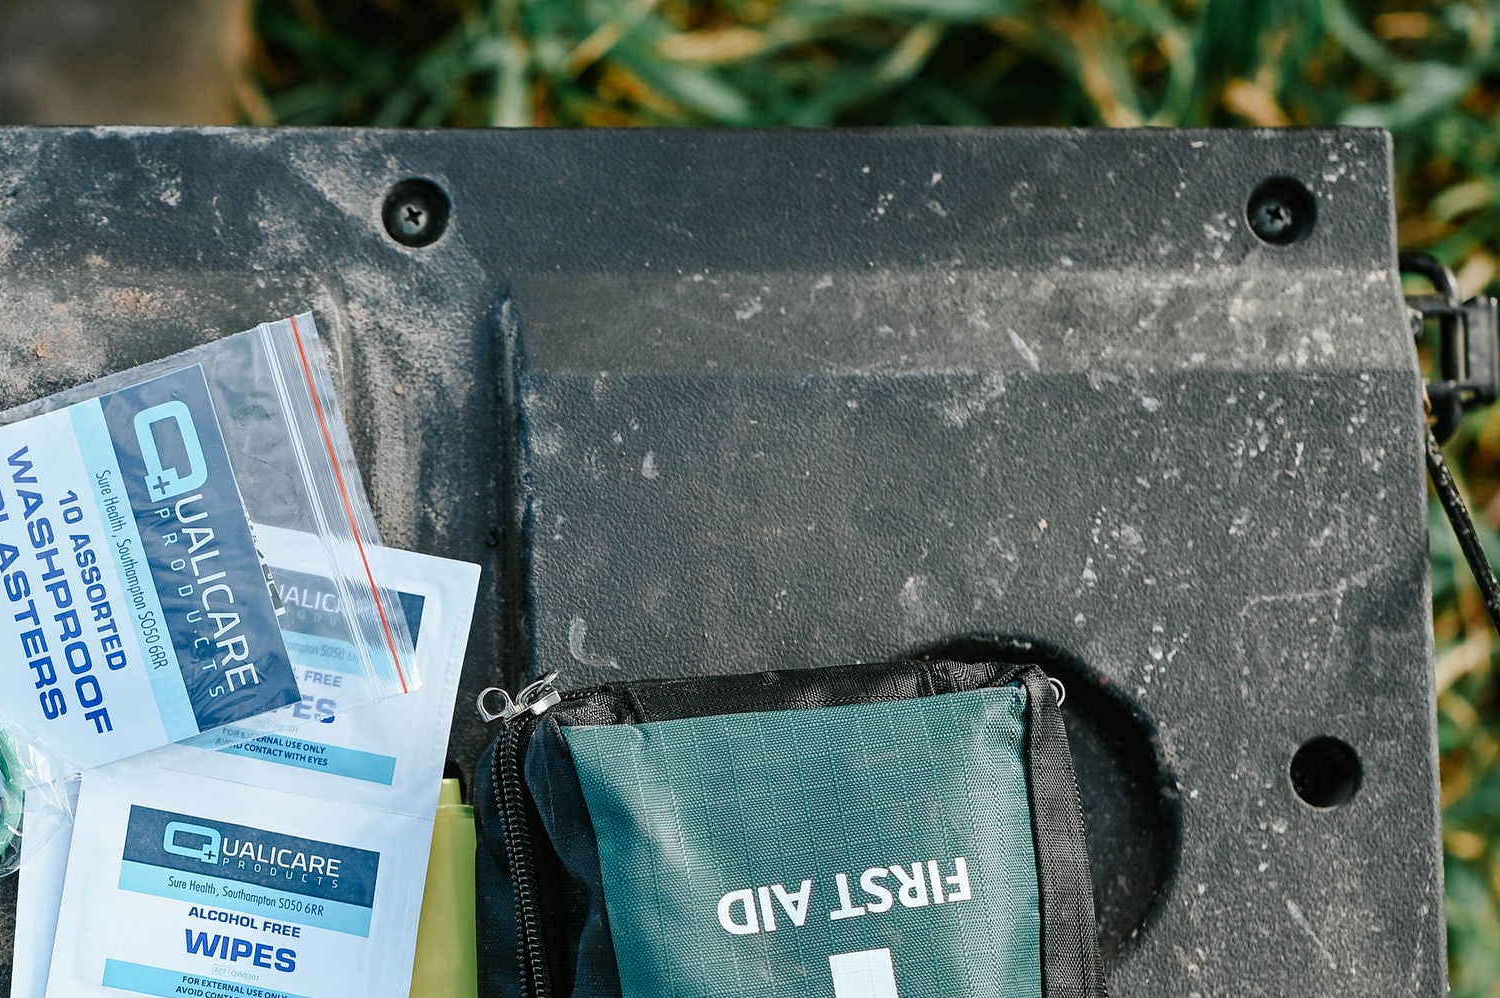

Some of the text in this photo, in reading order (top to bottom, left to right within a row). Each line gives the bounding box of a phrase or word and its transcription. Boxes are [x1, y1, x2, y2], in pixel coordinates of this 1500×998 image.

[133, 400, 260, 693] QUALICARE
[7, 445, 113, 734] WASHPROOF
[59, 489, 128, 672] 10 ASSORTED
[95, 469, 112, 496] Sure
[116, 538, 146, 610] Southampton
[148, 645, 169, 670] 6RR
[153, 509, 225, 698] PRODUCTS
[303, 669, 342, 687] FREE
[243, 742, 328, 766] CONTACT WITH EYES
[284, 739, 326, 754] USE ONLY
[163, 821, 341, 879] QUALICARE
[222, 858, 339, 888] PRODUCTS
[167, 875, 187, 890] Sure
[222, 885, 276, 907] Southampton
[303, 902, 324, 917] 6RR
[718, 857, 972, 935] FIRST AID
[188, 906, 301, 938] ALCOHOL FREE
[185, 929, 297, 973] WIPES
[175, 985, 204, 997] AVOID
[181, 975, 200, 986] FOR
[200, 979, 245, 995] EXTERNAL
[245, 987, 263, 998] USE
